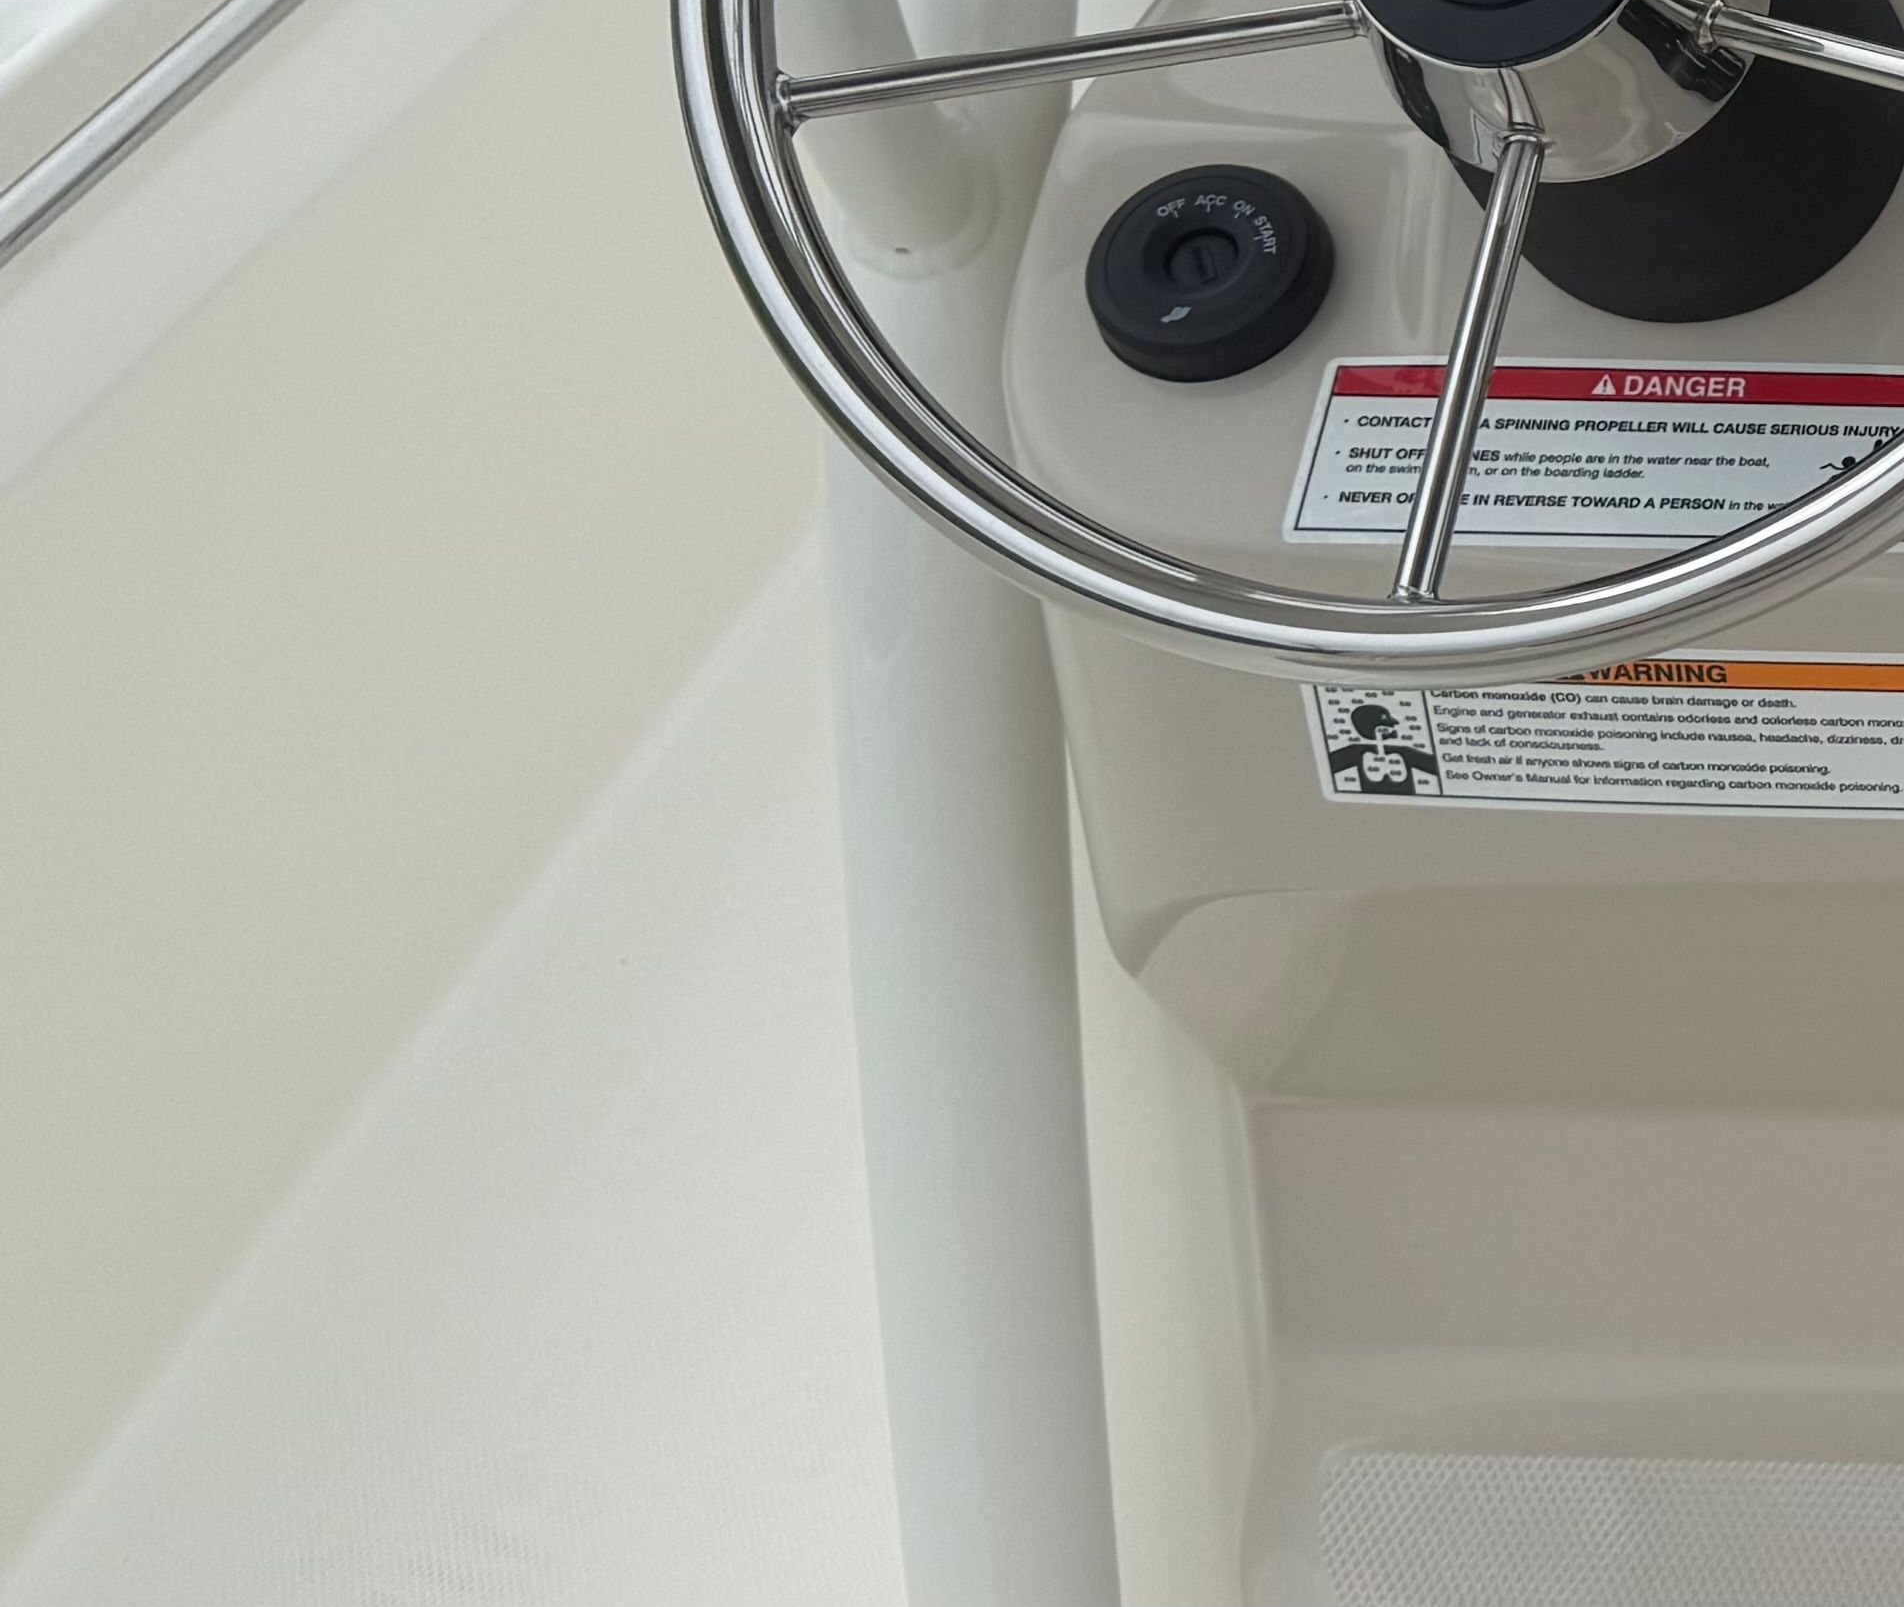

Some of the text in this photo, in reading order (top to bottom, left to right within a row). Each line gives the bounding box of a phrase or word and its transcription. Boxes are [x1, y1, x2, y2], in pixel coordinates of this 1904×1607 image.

[1156, 194, 1277, 254] OFF ACC ON START
[1623, 375, 1746, 398] DANGER
[1357, 415, 1432, 428] CONTACT
[1480, 418, 1491, 430] A
[1494, 418, 1570, 431] SPINNING
[1574, 419, 1668, 433] PROPELLER
[1672, 422, 1709, 434] WILL
[1713, 422, 1767, 435] CAUSE
[1770, 423, 1840, 436] SERIOUS
[1348, 447, 1427, 460] SHUT OFF
[1504, 451, 1536, 463] while
[1539, 452, 1583, 466] people
[1585, 455, 1605, 464] are
[1608, 453, 1620, 464] in
[1623, 454, 1643, 465] the
[1647, 455, 1682, 466] water
[1684, 457, 1713, 466] near
[1716, 456, 1736, 466] the
[1739, 456, 1770, 468] boat,
[1346, 464, 1421, 474] on the swim
[1485, 467, 1498, 476] or
[1501, 468, 1517, 476] on
[1521, 466, 1541, 477] the
[1544, 466, 1600, 480] boarding
[1603, 468, 1645, 479] ladder.
[1338, 491, 1392, 504] NEVER
[1472, 494, 1490, 505] IN
[1493, 495, 1567, 507] REVERSE
[1572, 496, 1641, 509] TOWARD
[1644, 498, 1655, 509] A
[1659, 498, 1725, 510] PERSON
[1728, 500, 1740, 510] in
[1744, 500, 1764, 511] the
[1589, 663, 1728, 683] WARNING
[1430, 689, 1797, 709] Carbon monoxide (CO) can cause brain damage or death.
[1433, 705, 1477, 718] Engine
[1480, 707, 1504, 717] and
[1507, 709, 1567, 720] generator
[1570, 711, 1619, 722] exhaust
[1622, 712, 1675, 723] contains
[1677, 714, 1731, 724] odorless
[1734, 715, 1758, 725] and
[1761, 716, 1818, 726] colorless
[1820, 717, 1864, 727] carbon
